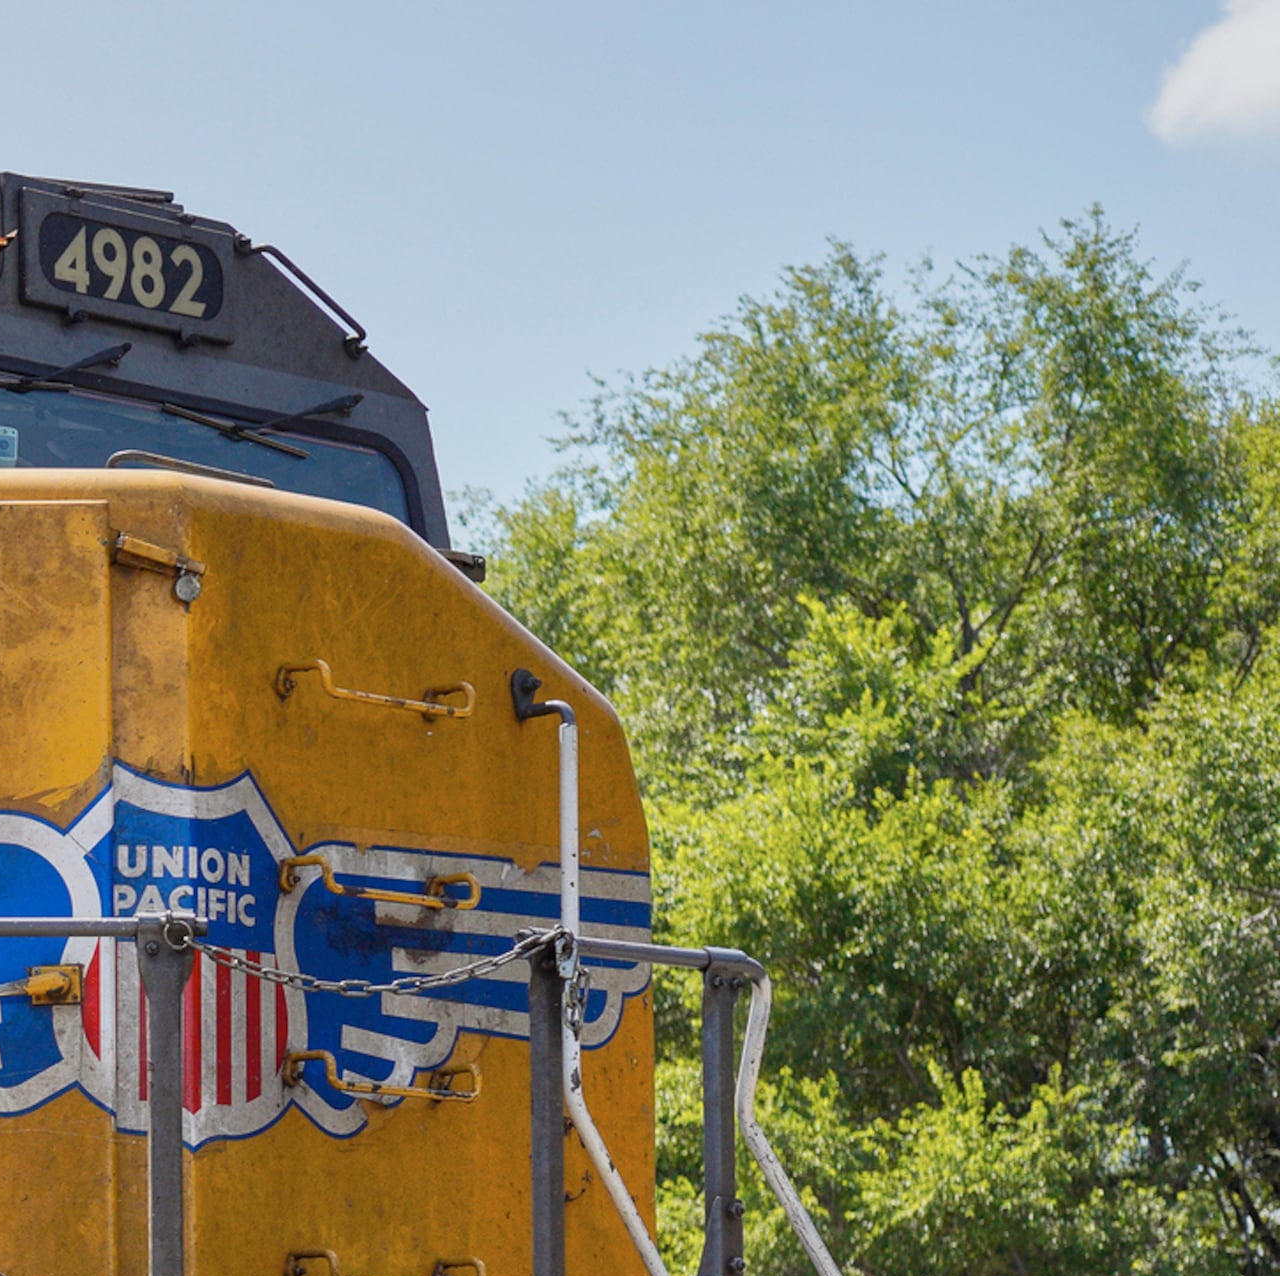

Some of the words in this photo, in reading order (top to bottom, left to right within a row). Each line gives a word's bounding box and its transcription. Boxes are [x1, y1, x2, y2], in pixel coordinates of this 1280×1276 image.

[54, 225, 206, 318] 4982
[117, 844, 250, 887] UNION
[113, 884, 256, 927] PACIFIC
